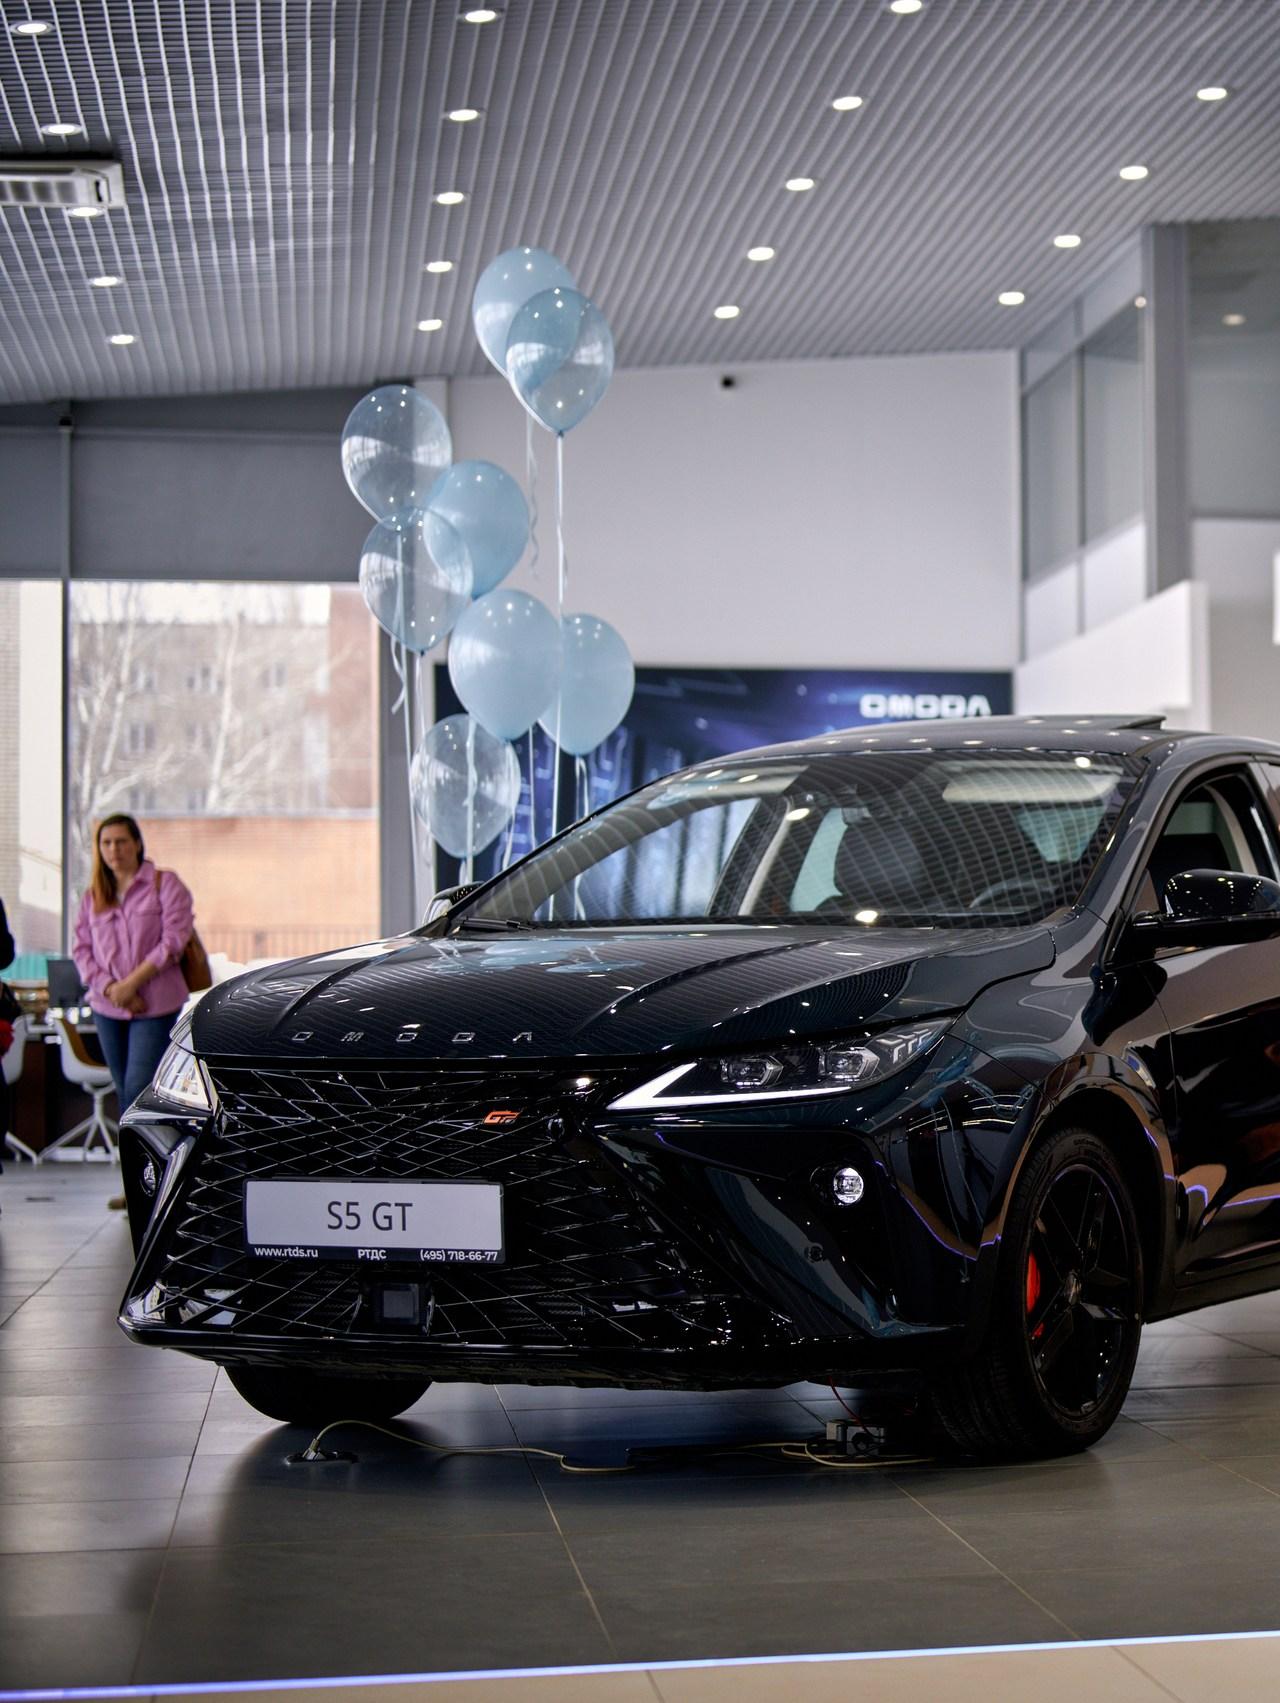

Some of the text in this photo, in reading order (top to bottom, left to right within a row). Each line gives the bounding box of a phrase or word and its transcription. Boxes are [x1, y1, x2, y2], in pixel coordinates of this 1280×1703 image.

[860, 694, 992, 718] OMODA
[291, 1031, 533, 1042] OMODA
[327, 1201, 413, 1231] S5 GT
[254, 1247, 319, 1258] www.rtds.ru
[357, 1249, 387, 1260] РТДС
[420, 1249, 498, 1262] (495) 718-66-77
